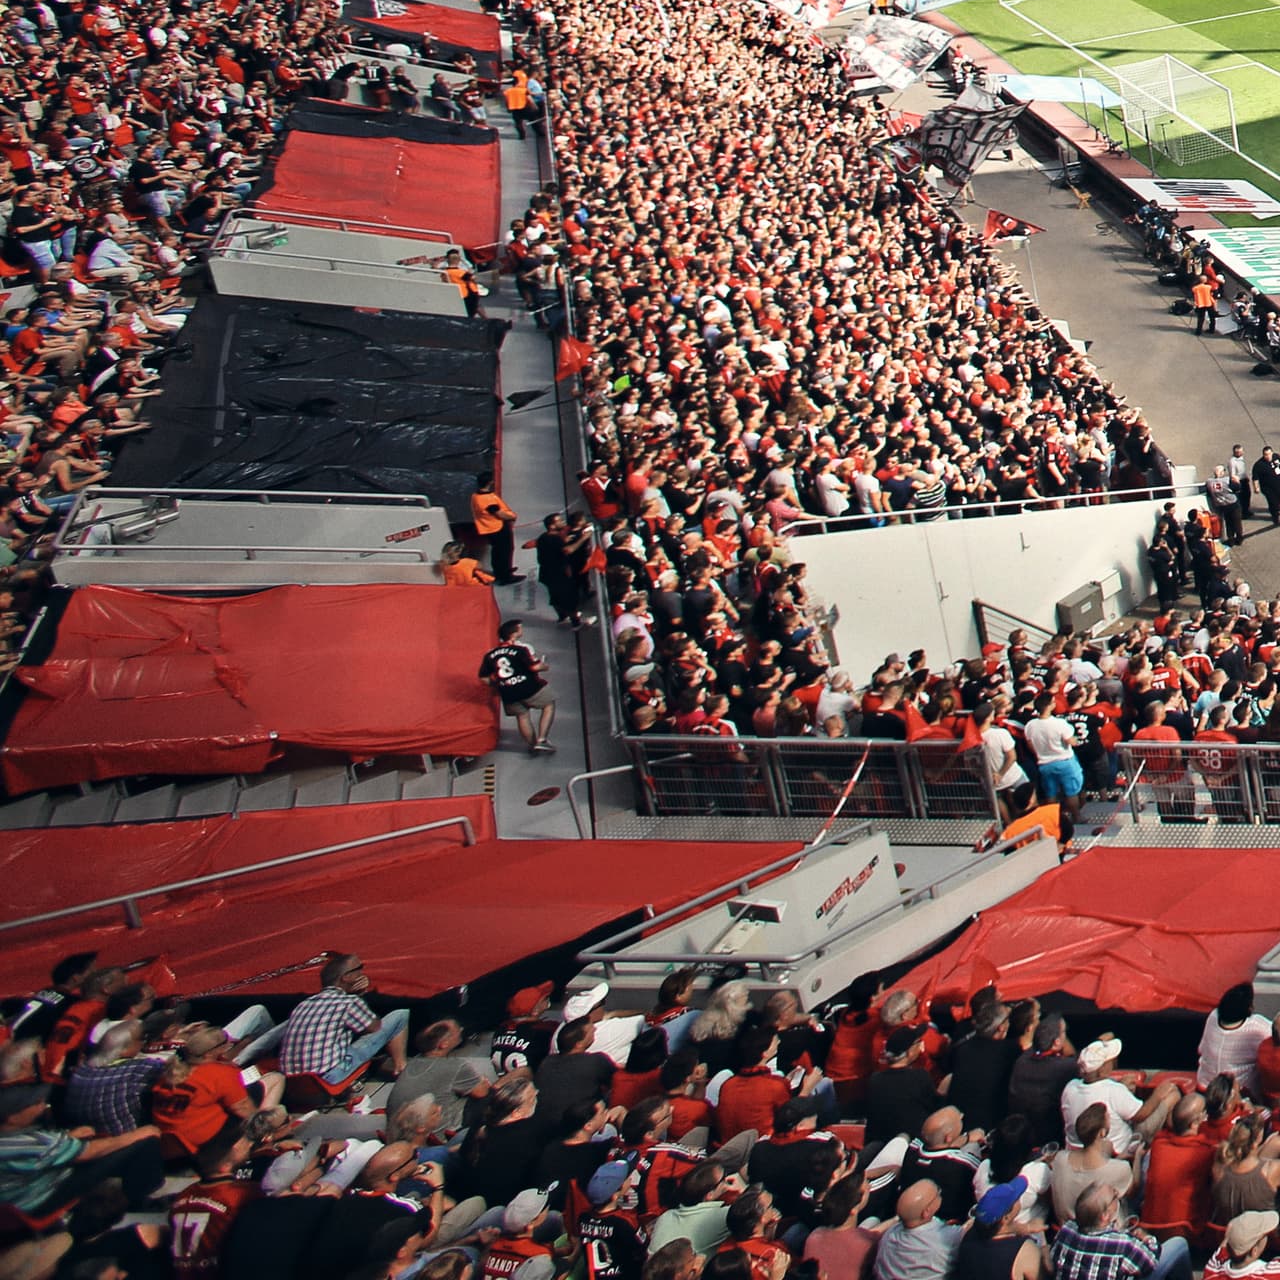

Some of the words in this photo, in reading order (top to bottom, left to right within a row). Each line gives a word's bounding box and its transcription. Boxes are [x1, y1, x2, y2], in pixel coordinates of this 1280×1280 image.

[497, 657, 514, 678] 8
[1198, 749, 1222, 770] 38
[492, 1036, 514, 1050] AYER
[515, 1037, 530, 1051] 04
[171, 1212, 212, 1258] 17
